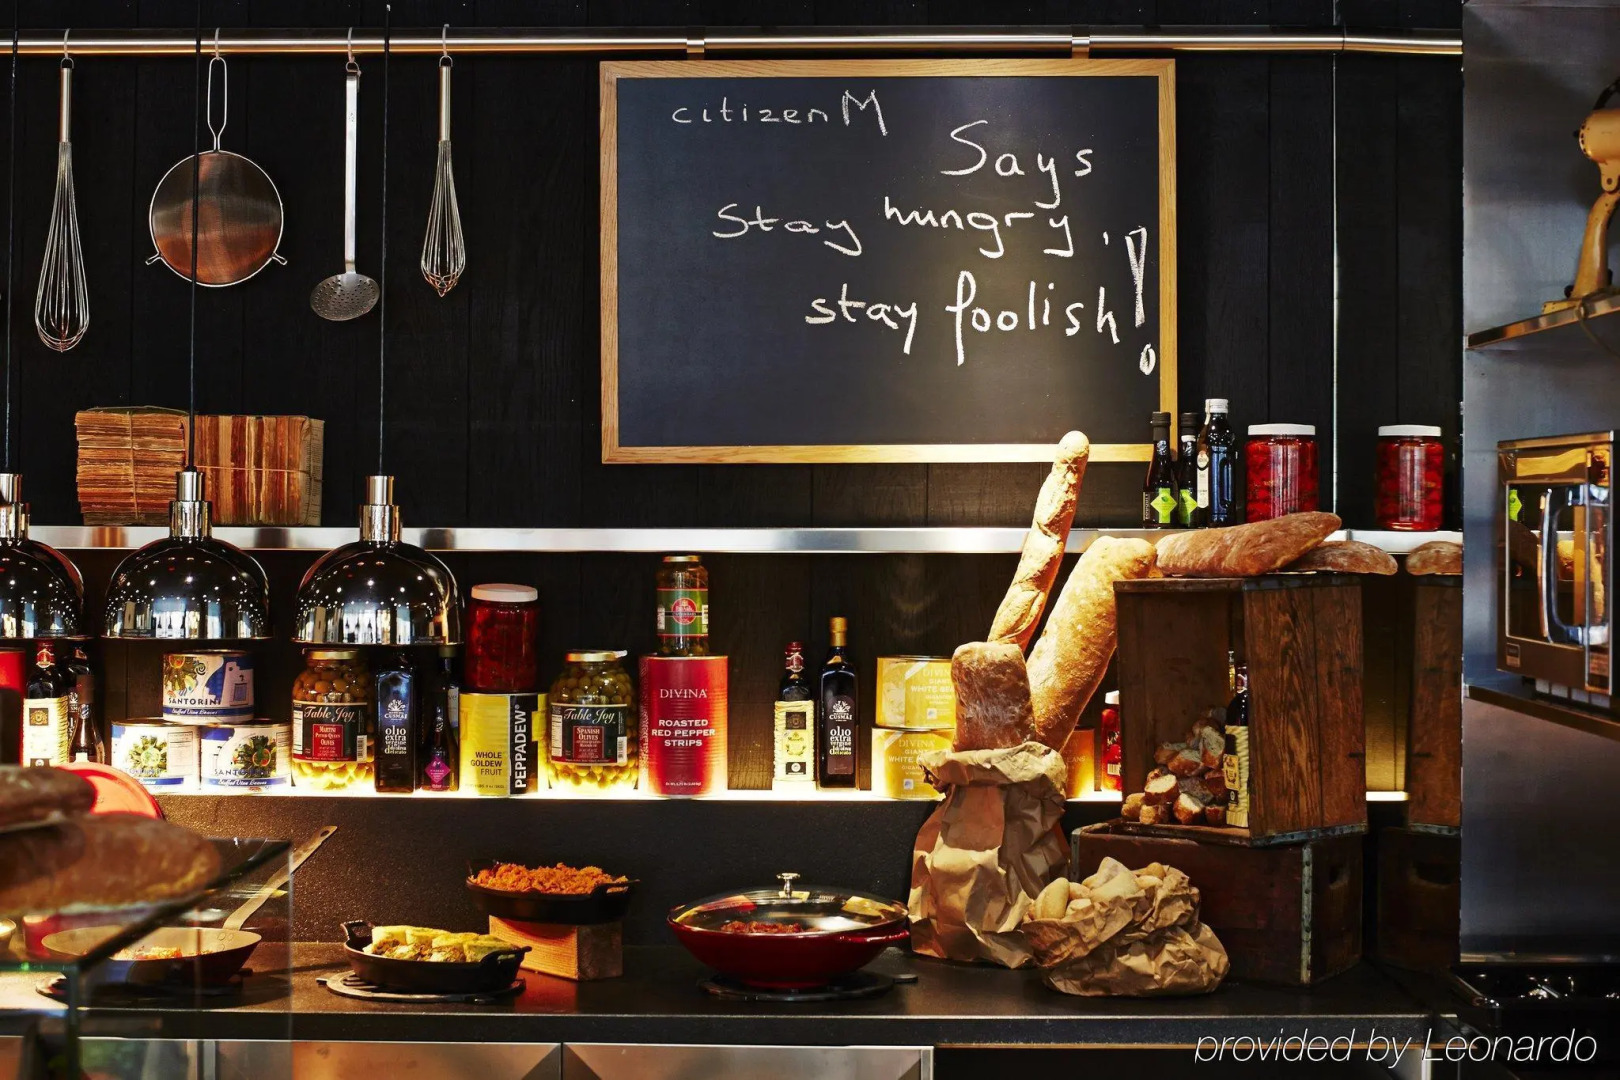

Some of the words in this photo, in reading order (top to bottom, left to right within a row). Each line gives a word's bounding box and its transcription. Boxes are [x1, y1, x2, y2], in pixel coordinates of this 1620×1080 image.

[940, 119, 1094, 209] Says
[712, 203, 863, 256] Stay
[805, 282, 917, 355] stay
[660, 688, 707, 698] DIVINA
[303, 706, 332, 719] Table
[331, 706, 355, 723] Joy
[563, 708, 592, 720] Table
[591, 708, 615, 724] Joy
[658, 718, 709, 727] ROASTED
[385, 724, 407, 735] olio
[651, 729, 672, 737] RED
[674, 728, 716, 737] PEPPER
[829, 725, 852, 736] olio
[664, 739, 703, 747] STRIPS
[475, 751, 502, 759] WHOLE
[470, 759, 503, 767] GOLDEW
[480, 768, 503, 776] FRUIT
